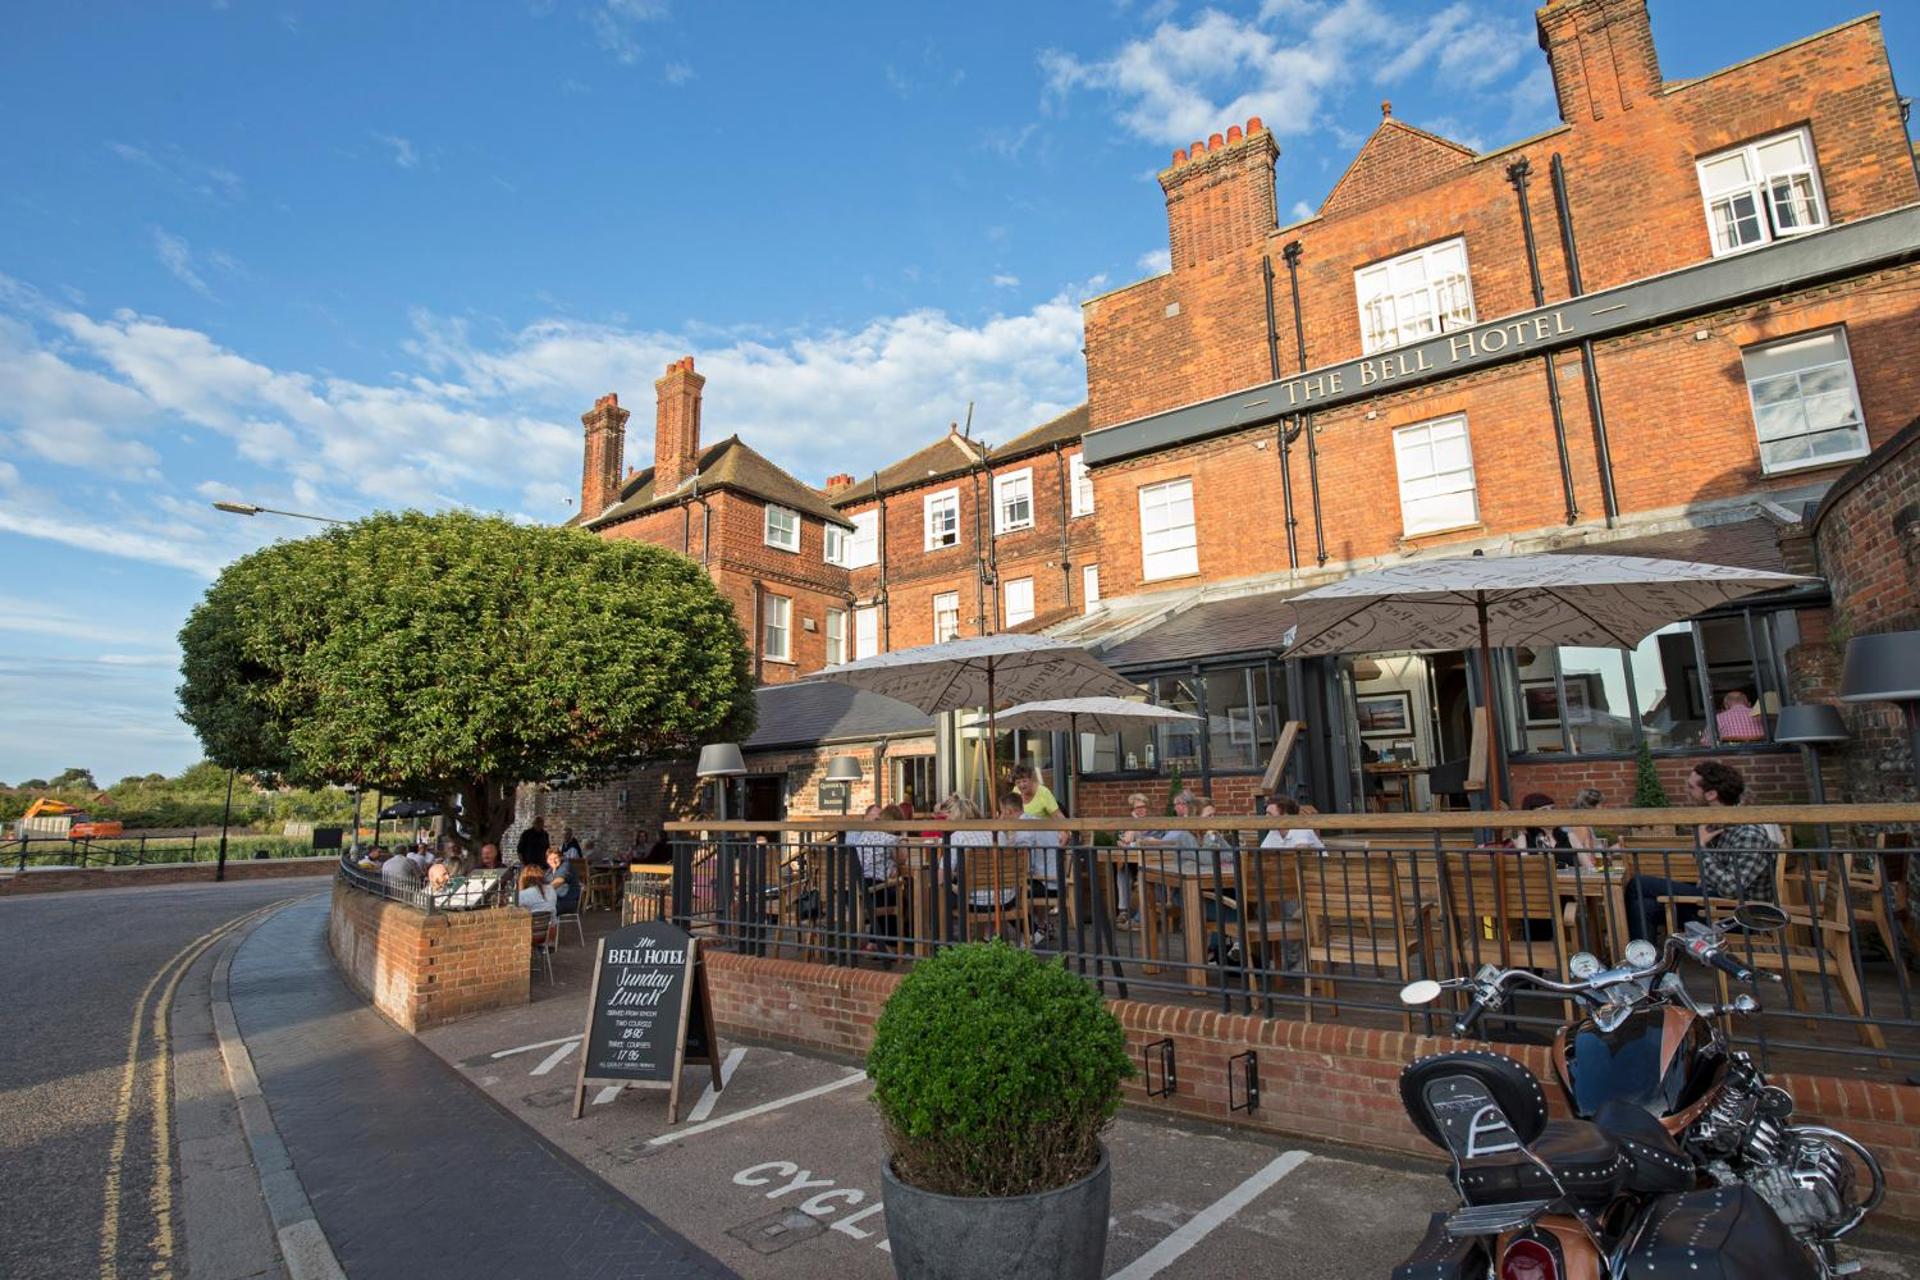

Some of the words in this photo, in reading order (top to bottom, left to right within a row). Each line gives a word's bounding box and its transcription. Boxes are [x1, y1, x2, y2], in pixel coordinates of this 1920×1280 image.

[1281, 372, 1344, 406] THE
[1358, 349, 1433, 387] BELL
[1448, 312, 1574, 363] HOTEL
[634, 936, 656, 948] The
[608, 949, 642, 964] BELL
[644, 949, 685, 965] HOTEL
[616, 966, 674, 993] Sunday
[608, 987, 661, 1006] Lunch
[732, 1161, 891, 1252] CYCL
